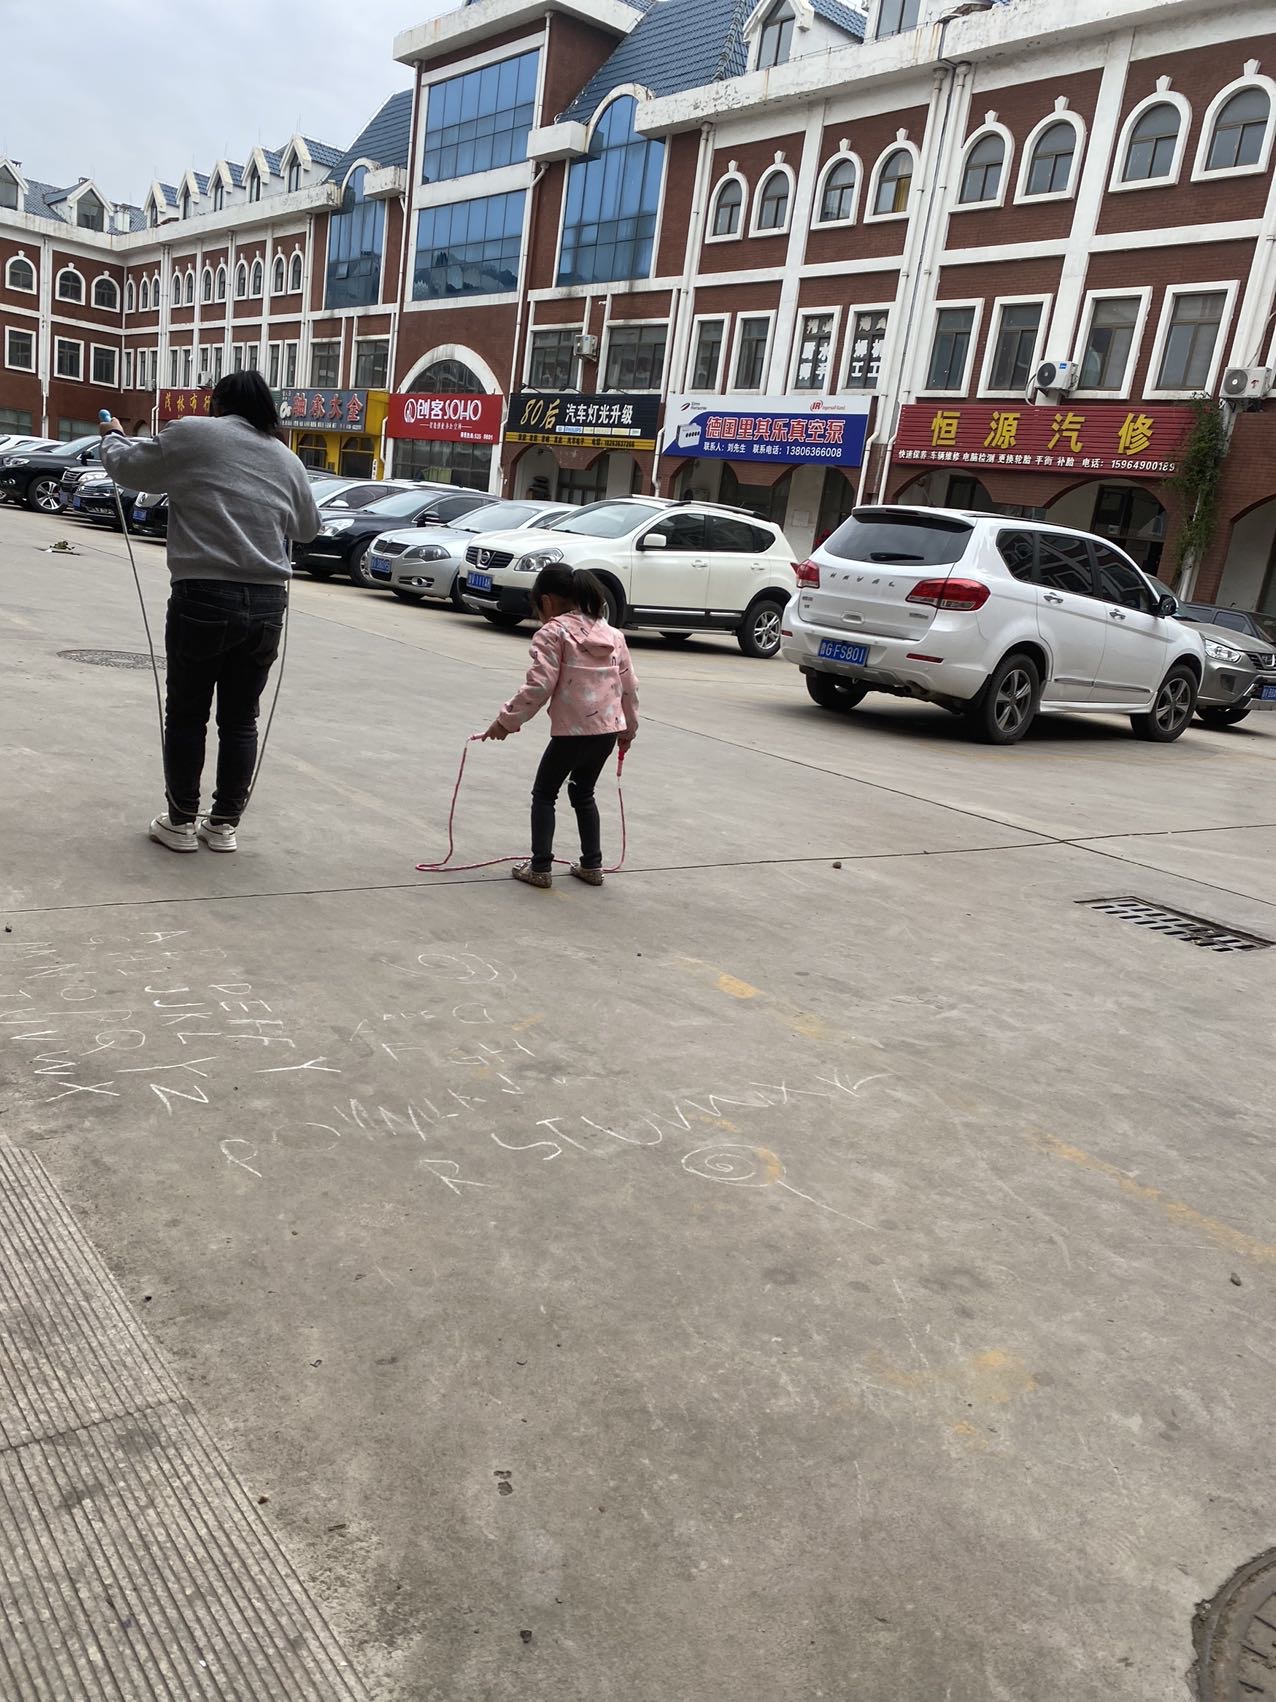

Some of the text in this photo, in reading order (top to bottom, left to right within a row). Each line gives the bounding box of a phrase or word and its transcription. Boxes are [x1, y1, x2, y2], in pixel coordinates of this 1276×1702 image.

[292, 392, 363, 421] 轴承大全
[520, 398, 634, 430] 80后 汽车灯光升级
[705, 416, 846, 444] 德国里其乐真空泵
[930, 410, 1155, 456] 恒源汽修
[898, 450, 928, 459] 快速保养
[930, 451, 960, 461] 车辆维修
[962, 453, 995, 463] 电脑检测
[997, 454, 1032, 464] 更换轮胎
[830, 572, 896, 588] HAVAL
